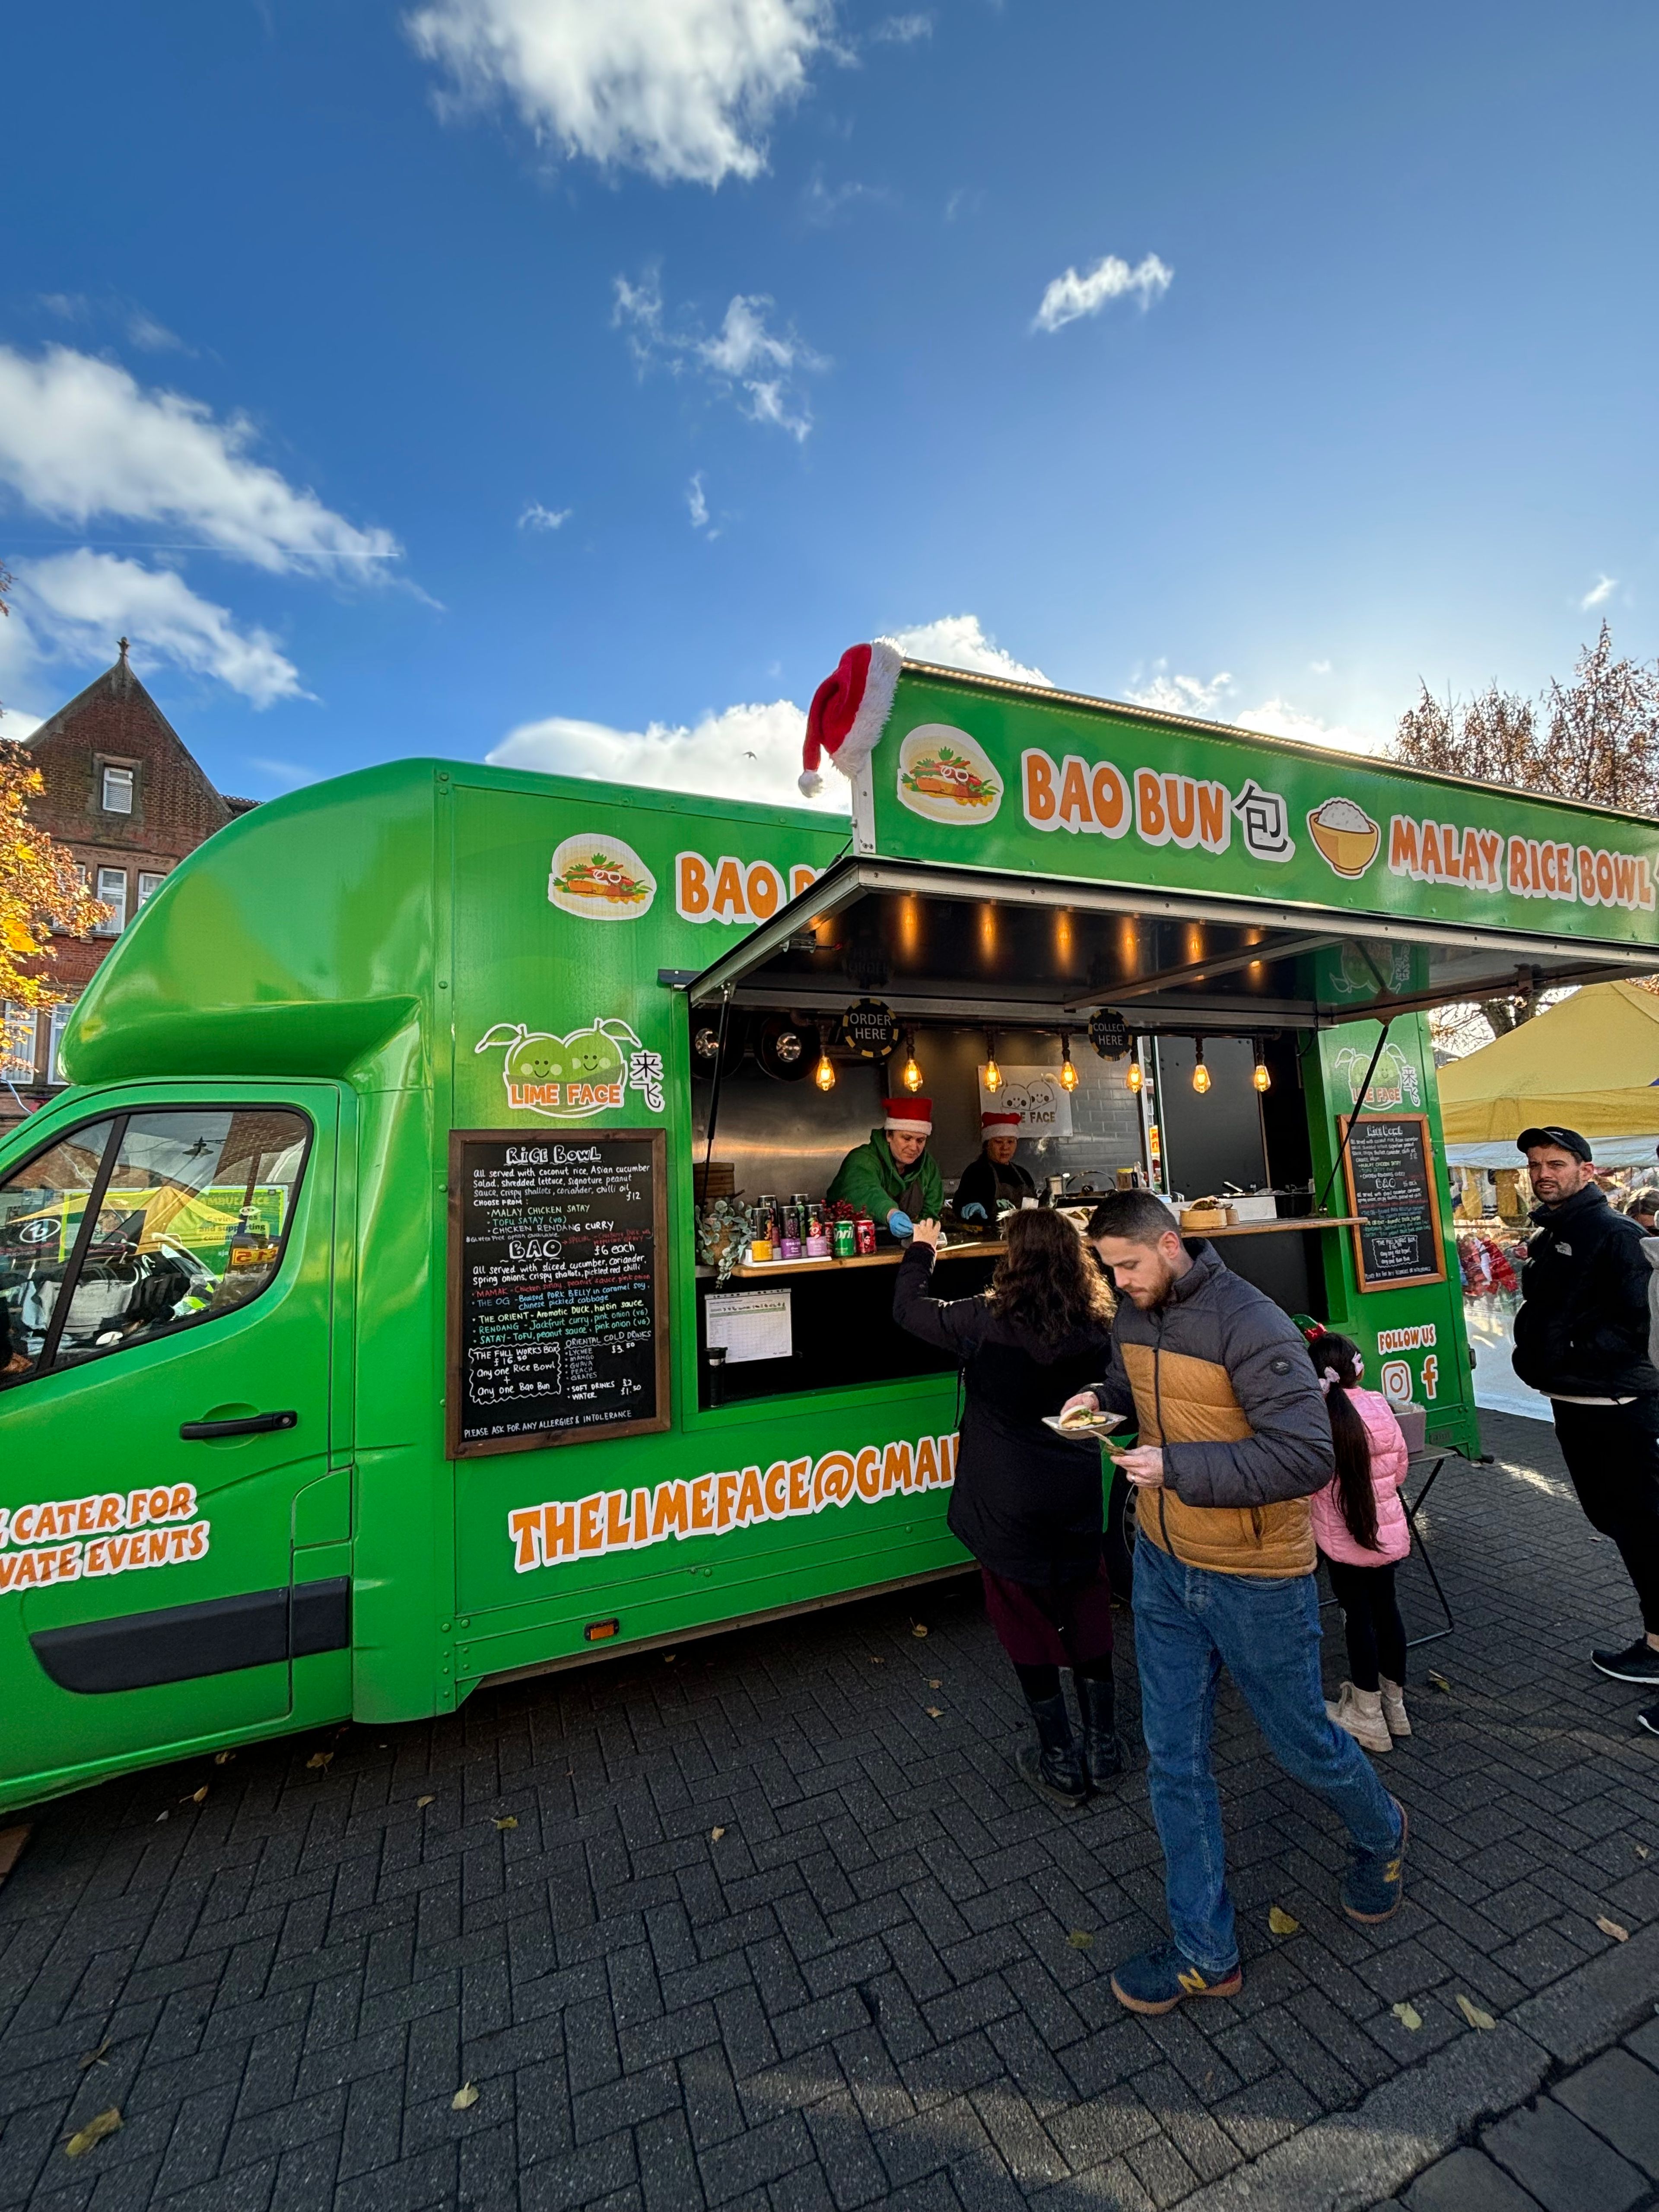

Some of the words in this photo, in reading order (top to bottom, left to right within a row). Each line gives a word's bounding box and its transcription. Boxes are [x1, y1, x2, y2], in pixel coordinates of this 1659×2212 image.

[1027, 754, 1124, 829] BAO
[1138, 772, 1224, 845] BUN
[1235, 785, 1289, 853] 包
[1391, 818, 1500, 886] MALAY
[1509, 840, 1572, 894] RICE
[681, 856, 779, 919] BAO
[850, 1013, 891, 1027] ORDER
[855, 1028, 887, 1040] HERE
[1093, 1022, 1125, 1033] COLLECT
[1098, 1034, 1123, 1046] HERE
[632, 1052, 663, 1110] 来飞
[512, 1084, 559, 1106] LIME
[568, 1084, 622, 1105] FACE
[1377, 1088, 1400, 1102] FACE
[1030, 1111, 1055, 1123] FACE
[489, 1168, 514, 1177] served
[518, 1167, 535, 1177] with
[539, 1167, 569, 1176] coconut
[591, 1166, 613, 1174] Asian
[616, 1163, 650, 1173] cucumber
[502, 1178, 535, 1187] shredded
[606, 1174, 632, 1186] peanut
[500, 1189, 521, 1199] crispy
[596, 1185, 616, 1193] chilli
[619, 1184, 629, 1192] oil
[626, 1192, 641, 1201] £12
[491, 1208, 522, 1217] MALAY
[528, 1207, 562, 1215] CHICKEN
[567, 1205, 590, 1213] SATAY
[493, 1225, 532, 1234] CHICKEN
[537, 1224, 580, 1232] RENDANG
[585, 1221, 614, 1231] CURRY
[518, 1217, 543, 1225] SATAY
[509, 1239, 561, 1259] BAO
[594, 1245, 608, 1255] £6
[611, 1241, 635, 1254] each
[489, 1265, 515, 1274] served
[520, 1263, 537, 1273] with
[542, 1262, 566, 1271] sliced
[473, 1276, 498, 1288] spring
[529, 1272, 553, 1283] crispy
[585, 1267, 609, 1279] pickled
[623, 1263, 641, 1271] chilli
[477, 1287, 509, 1297] MAMAK
[477, 1299, 493, 1307] THE
[496, 1297, 510, 1305] OG
[568, 1288, 591, 1297] BELLY
[602, 1283, 630, 1293] caramel
[549, 1297, 575, 1309] pickled
[578, 1295, 609, 1304] cabbage
[478, 1315, 495, 1324] THE
[498, 1312, 529, 1322] ORIENT
[537, 1308, 568, 1319] Aromatic
[594, 1303, 617, 1312] hoisin
[621, 1300, 644, 1308] sauce
[479, 1322, 519, 1335] RENDANG
[529, 1318, 566, 1330] Jackfruit
[594, 1313, 609, 1324] pink
[537, 1328, 562, 1341] peanut
[595, 1322, 610, 1333] pink
[611, 1320, 630, 1329] onion
[566, 1337, 601, 1347] ORIENTAL
[604, 1332, 625, 1342] COLD
[627, 1330, 652, 1339] DRINKS
[1379, 1329, 1418, 1351] FOLLOW
[1422, 1326, 1434, 1344] US
[474, 1351, 492, 1360] THE
[494, 1349, 513, 1358] FULL
[516, 1347, 542, 1356] WORKS
[569, 1348, 594, 1356] LYCHEE
[494, 1367, 510, 1376] one
[513, 1364, 531, 1373] Rice
[533, 1361, 555, 1371] Bowl
[569, 1360, 593, 1369] GUAVA
[571, 1367, 593, 1375] PEACH
[570, 1372, 597, 1381] GRAPES
[499, 1386, 515, 1394] one
[519, 1382, 534, 1392] Bao
[537, 1382, 550, 1391] Bun
[571, 1384, 587, 1392] SOFT
[591, 1381, 615, 1390] DRINKS
[623, 1379, 632, 1387] £2
[572, 1392, 597, 1401] WATER
[464, 1427, 489, 1438] PLEASE
[491, 1426, 505, 1435] ASK
[507, 1422, 521, 1433] FOR
[522, 1421, 537, 1431] ANY
[539, 1417, 573, 1429] ALLERGIES
[583, 1410, 632, 1423] INTOLERANCE
[15, 1497, 121, 1540] CATER
[130, 1487, 191, 1524] FOR
[88, 1525, 204, 1572] EVENTS
